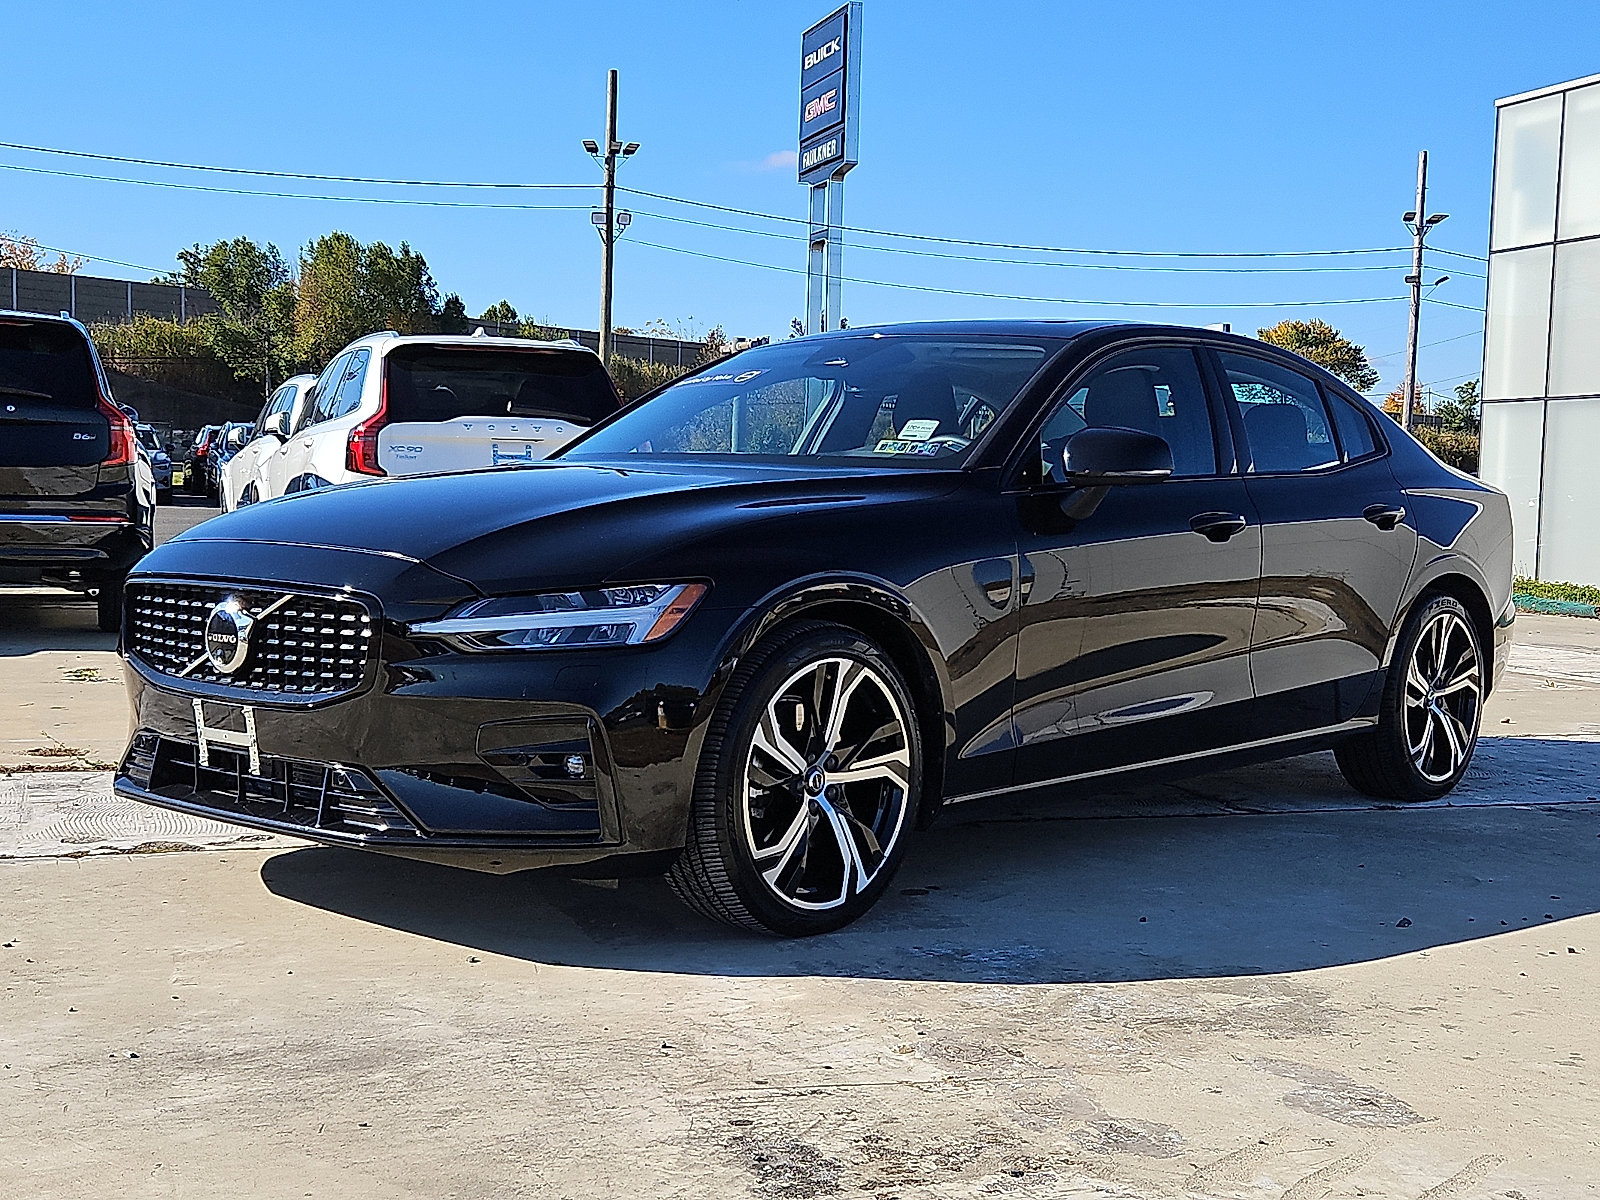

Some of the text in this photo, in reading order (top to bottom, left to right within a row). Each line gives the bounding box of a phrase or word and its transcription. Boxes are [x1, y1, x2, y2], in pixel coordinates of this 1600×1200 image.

[804, 37, 841, 70] BUICK
[804, 88, 838, 122] GMC
[803, 138, 837, 169] FAULKNER
[388, 445, 423, 453] XC90
[207, 633, 237, 643] VOLVO
